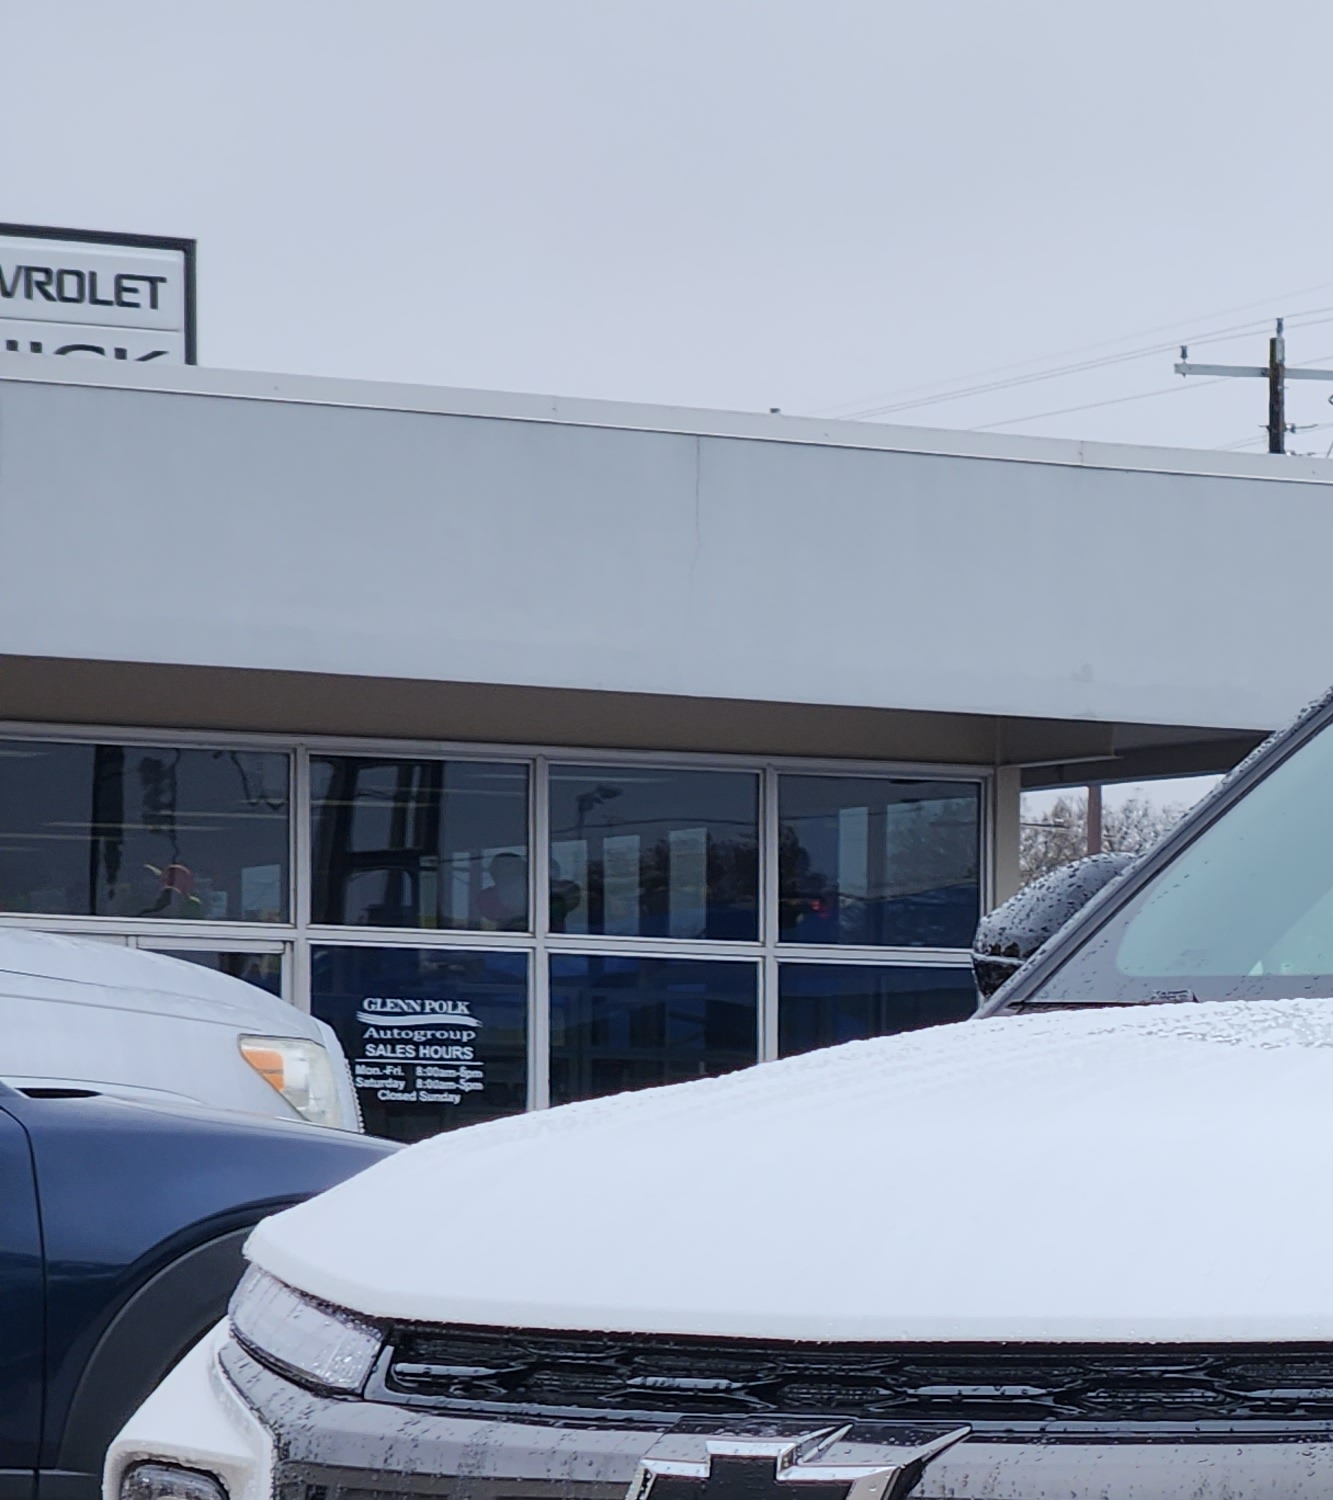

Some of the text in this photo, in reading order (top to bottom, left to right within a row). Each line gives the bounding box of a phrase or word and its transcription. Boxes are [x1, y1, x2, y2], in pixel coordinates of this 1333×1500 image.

[363, 998, 471, 1014] GLENN POLK
[363, 1027, 476, 1042] Autogroup
[365, 1044, 474, 1060] SALES HOURS
[355, 1077, 406, 1090] Saturday
[377, 1090, 462, 1105] Closed Sunday
